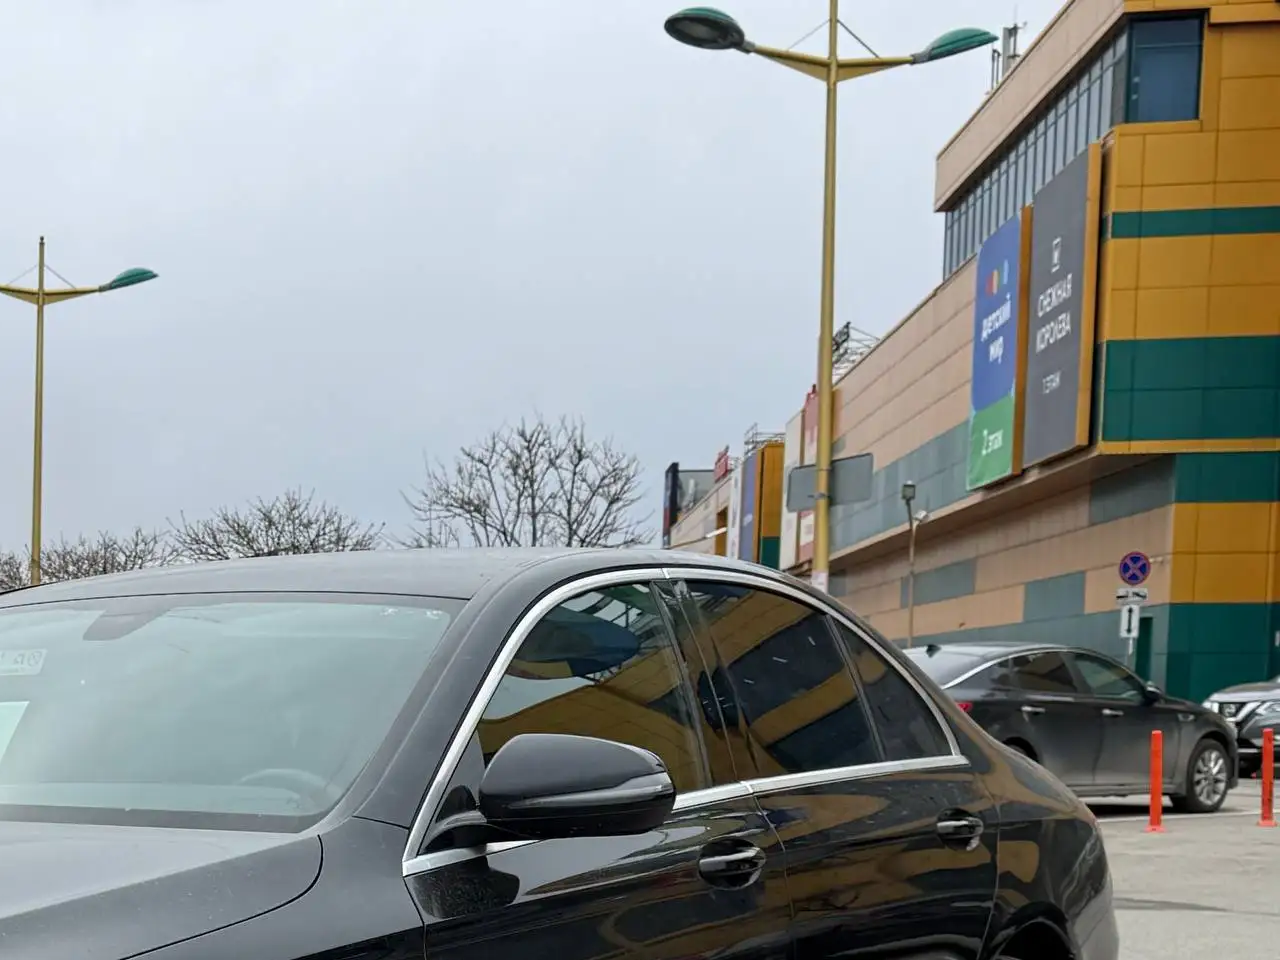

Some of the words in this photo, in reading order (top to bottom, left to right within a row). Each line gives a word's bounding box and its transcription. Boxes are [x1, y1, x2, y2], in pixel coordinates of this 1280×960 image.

[1038, 273, 1072, 318] СНЕЖНАЯ
[981, 292, 1011, 342] детский
[1036, 311, 1072, 353] КОРОЛЕВА
[989, 336, 1004, 364] мир
[982, 428, 989, 456] 2
